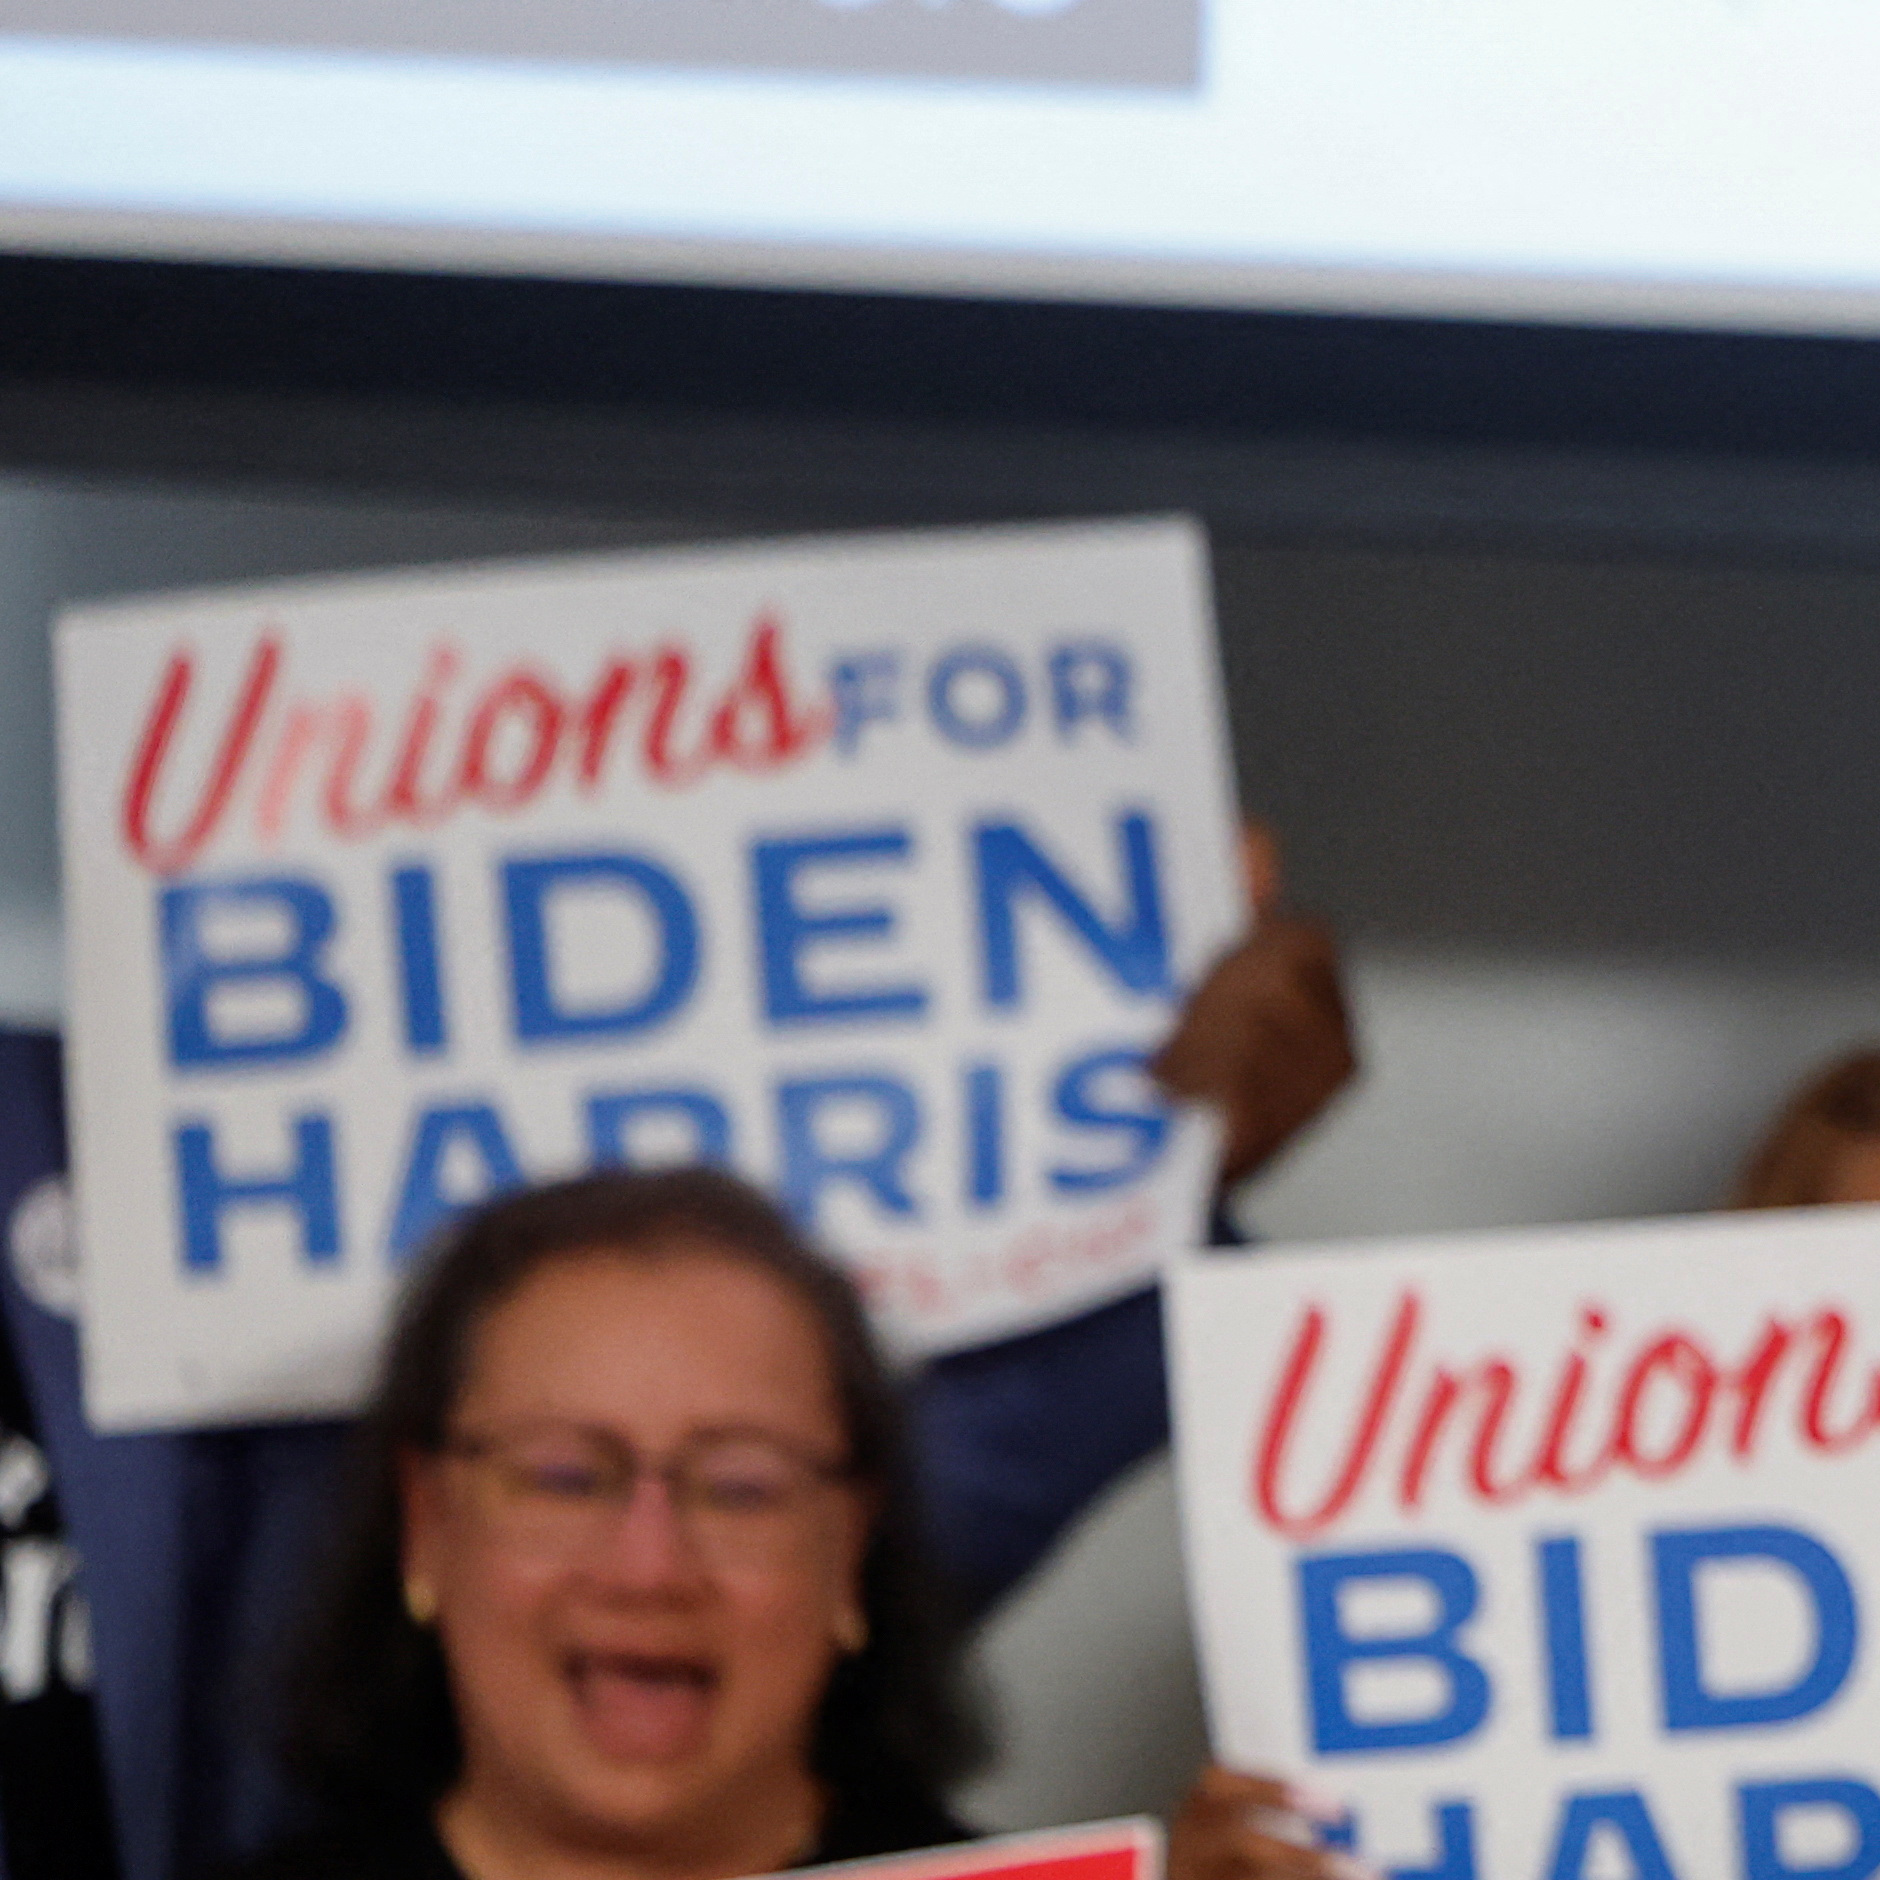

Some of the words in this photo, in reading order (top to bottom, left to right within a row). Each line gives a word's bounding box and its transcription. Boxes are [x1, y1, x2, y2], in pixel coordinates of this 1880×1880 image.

[120, 606, 833, 876] Unions
[828, 634, 1144, 759] FOR
[157, 805, 1178, 1080] BIDEN
